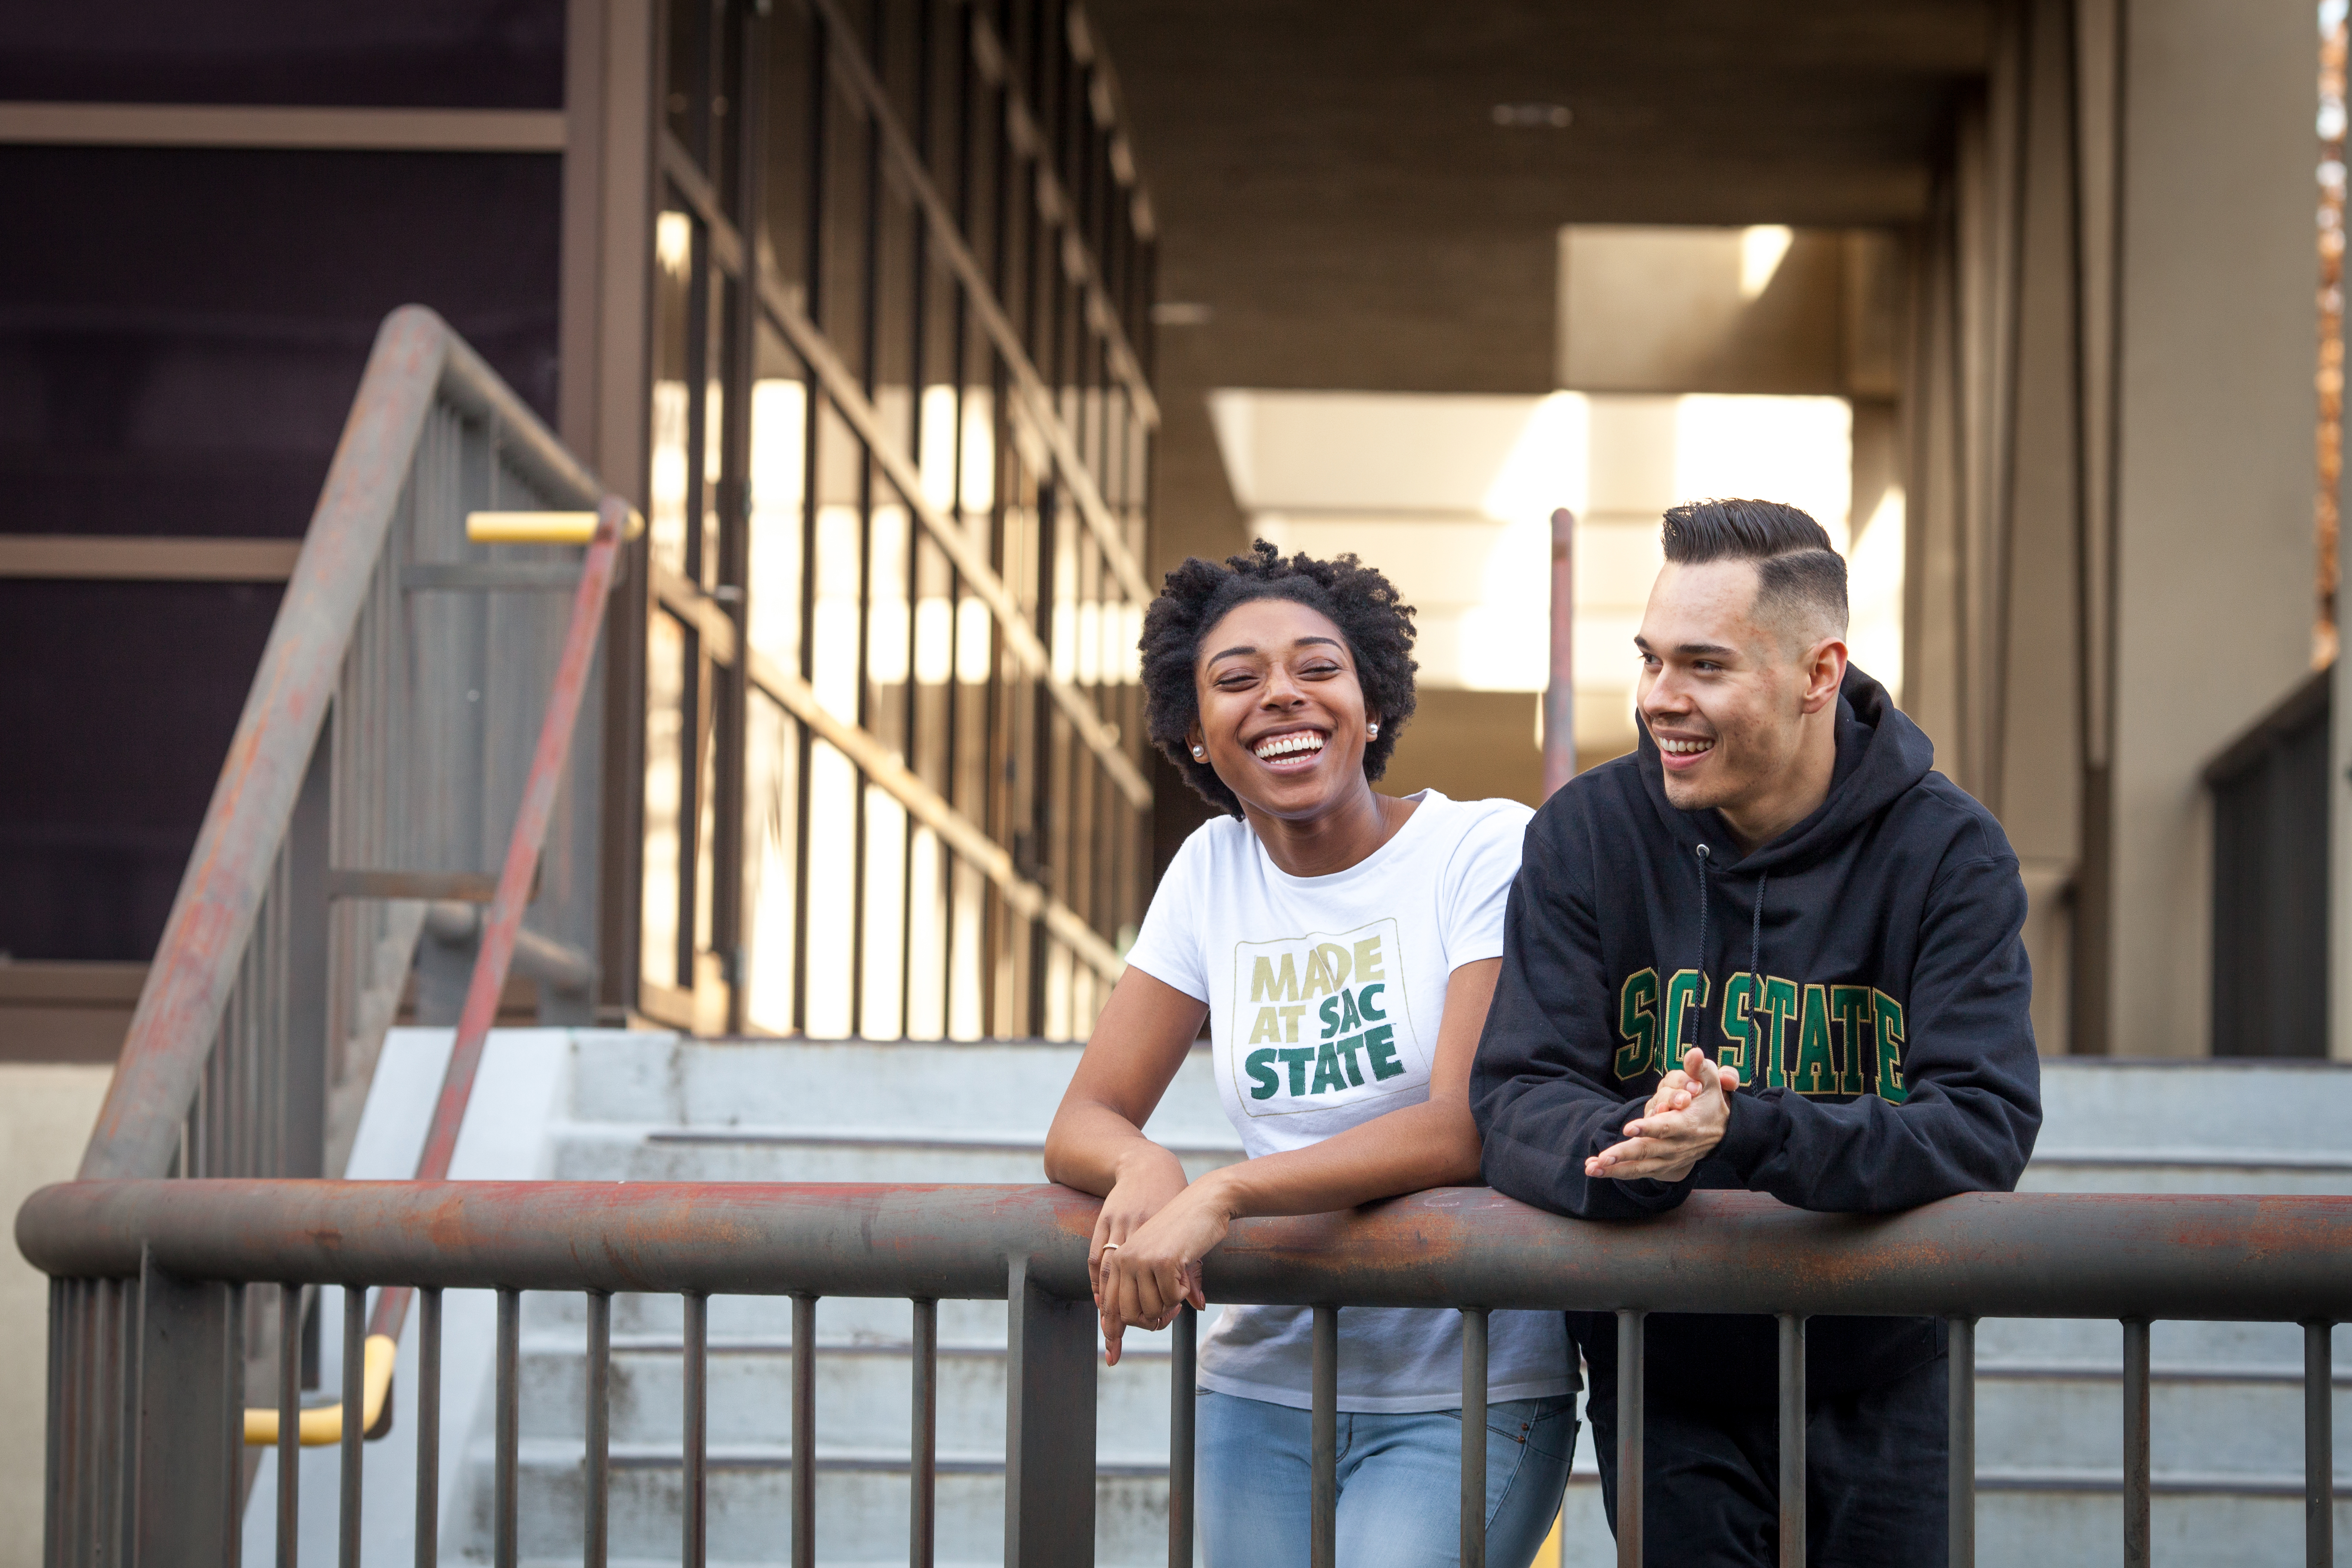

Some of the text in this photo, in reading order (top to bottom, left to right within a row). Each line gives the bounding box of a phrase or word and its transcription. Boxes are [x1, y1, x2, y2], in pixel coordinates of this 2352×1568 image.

[1249, 934, 1385, 1002] MADE
[1248, 984, 1387, 1044] AT SAC
[1614, 967, 1909, 1106] SC STATE
[1245, 1023, 1406, 1100] STATE
